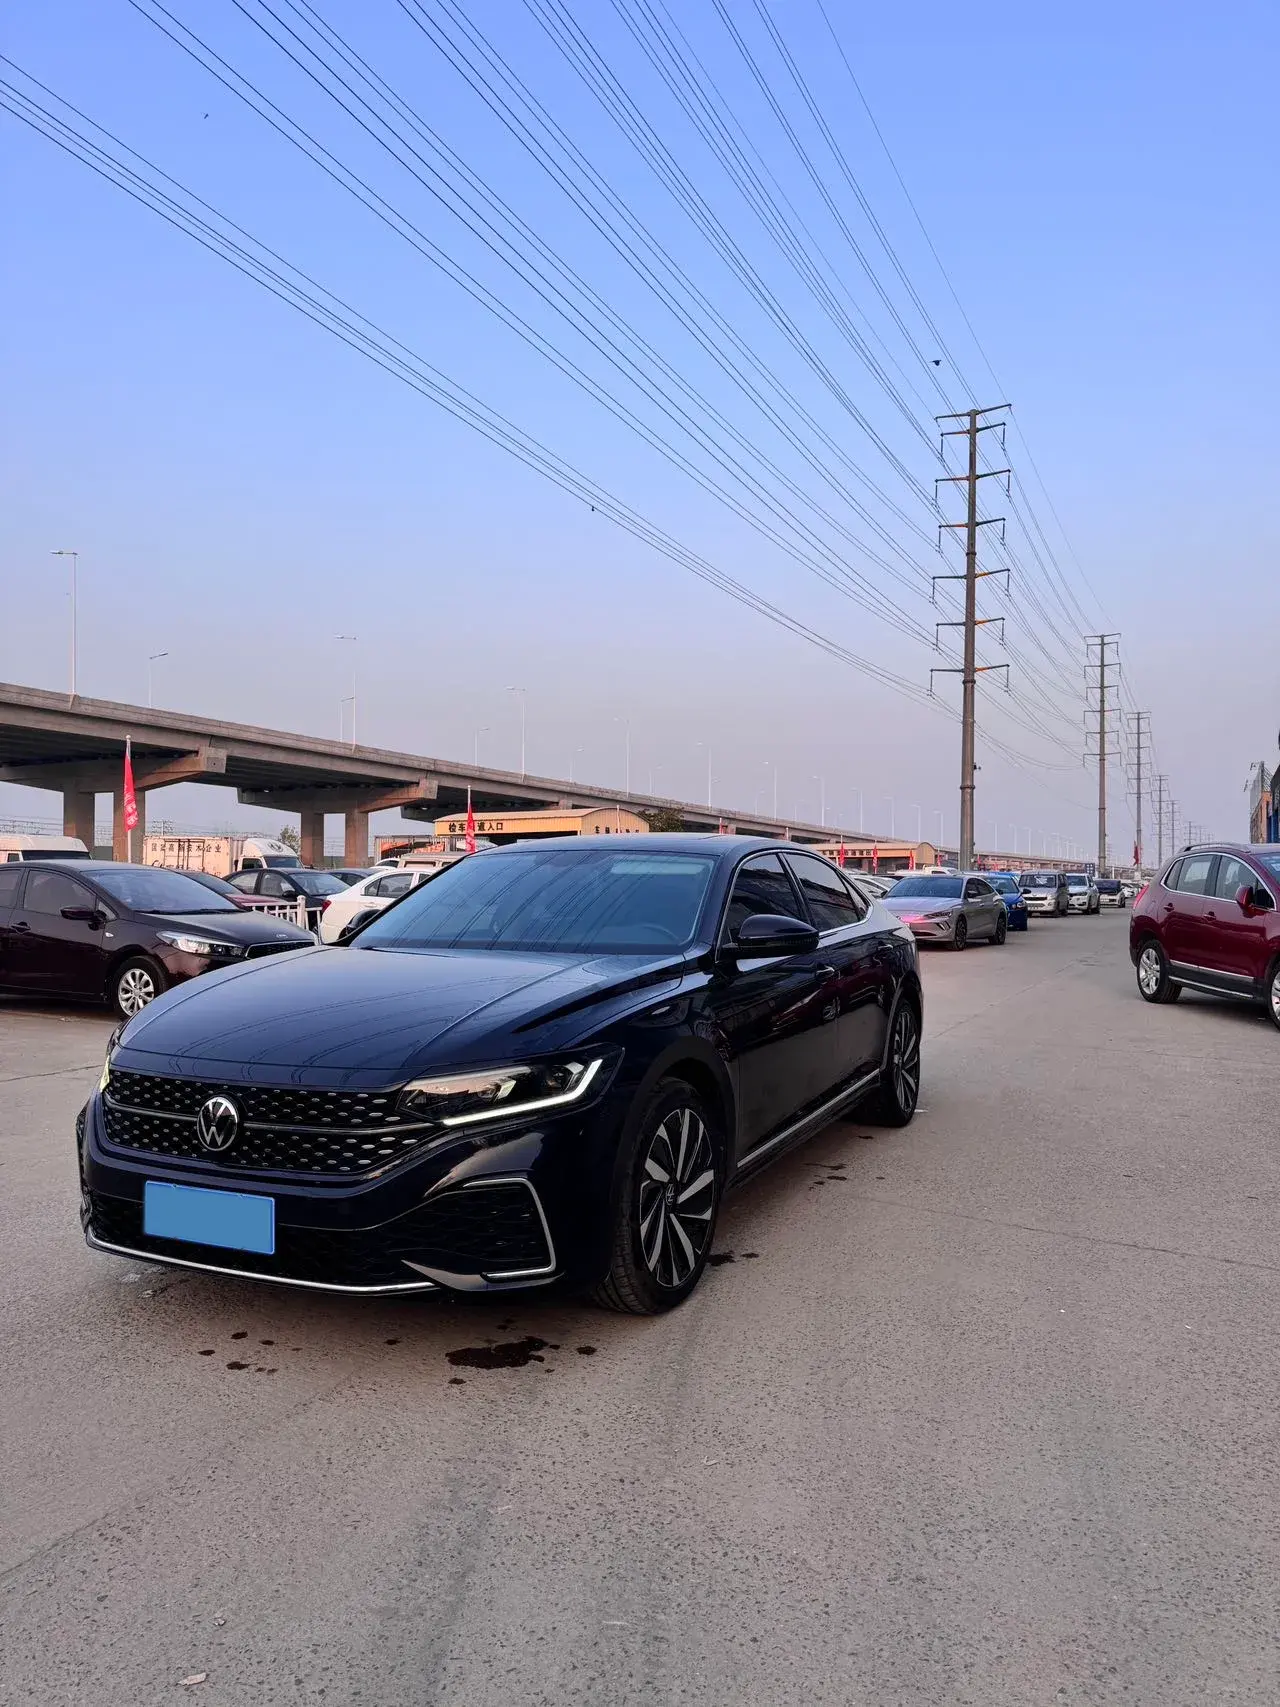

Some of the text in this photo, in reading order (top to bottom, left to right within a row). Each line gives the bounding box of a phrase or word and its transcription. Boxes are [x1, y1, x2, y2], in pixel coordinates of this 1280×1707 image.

[448, 822, 504, 833] 检车道入口
